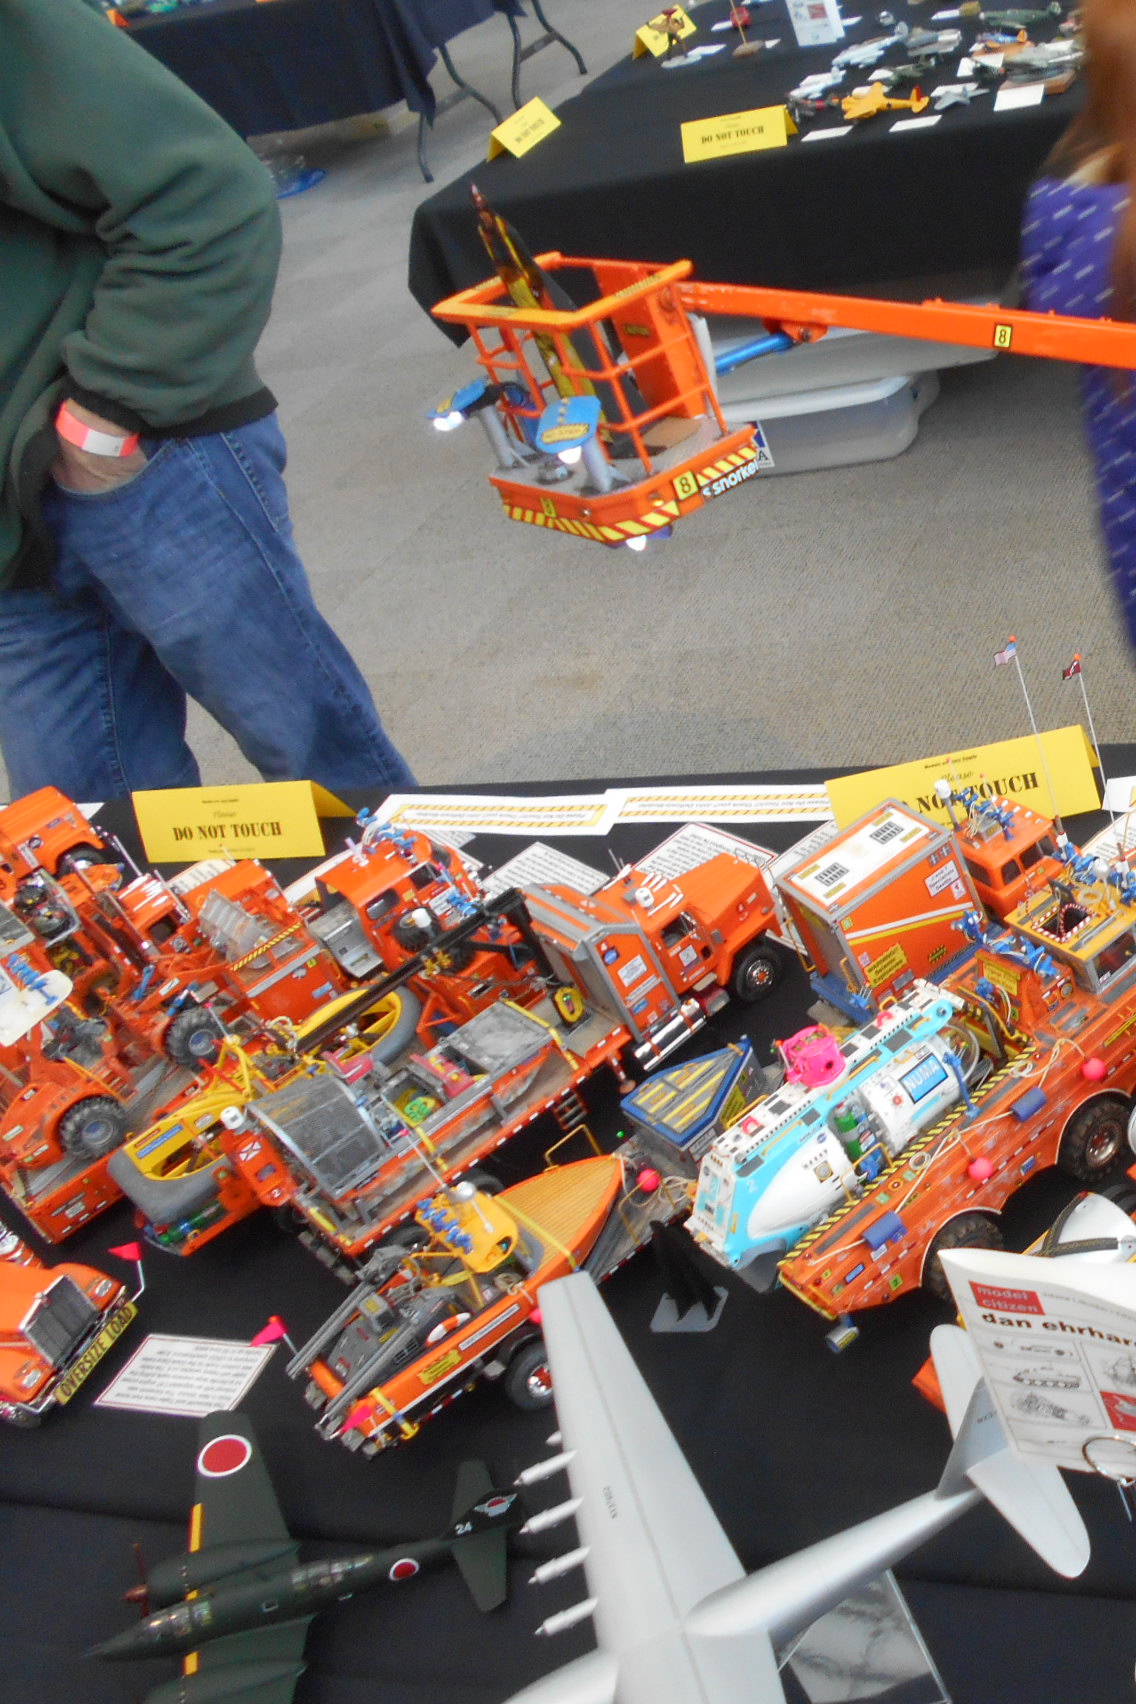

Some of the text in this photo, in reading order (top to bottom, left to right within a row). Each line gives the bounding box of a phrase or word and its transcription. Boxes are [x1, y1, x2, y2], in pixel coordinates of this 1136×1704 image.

[701, 126, 764, 144] DO NOT TOUCH
[997, 327, 1008, 345] 8
[680, 476, 692, 494] 8
[713, 459, 759, 497] snorkel
[172, 821, 282, 841] DO NOT TOUCH
[901, 1057, 941, 1092] NUMA
[976, 1285, 1029, 1300] model
[982, 1298, 1039, 1313] citizen
[981, 1312, 1032, 1329] dan
[60, 1306, 133, 1397] OVERSIZE LOAD
[454, 1520, 473, 1535] 24
